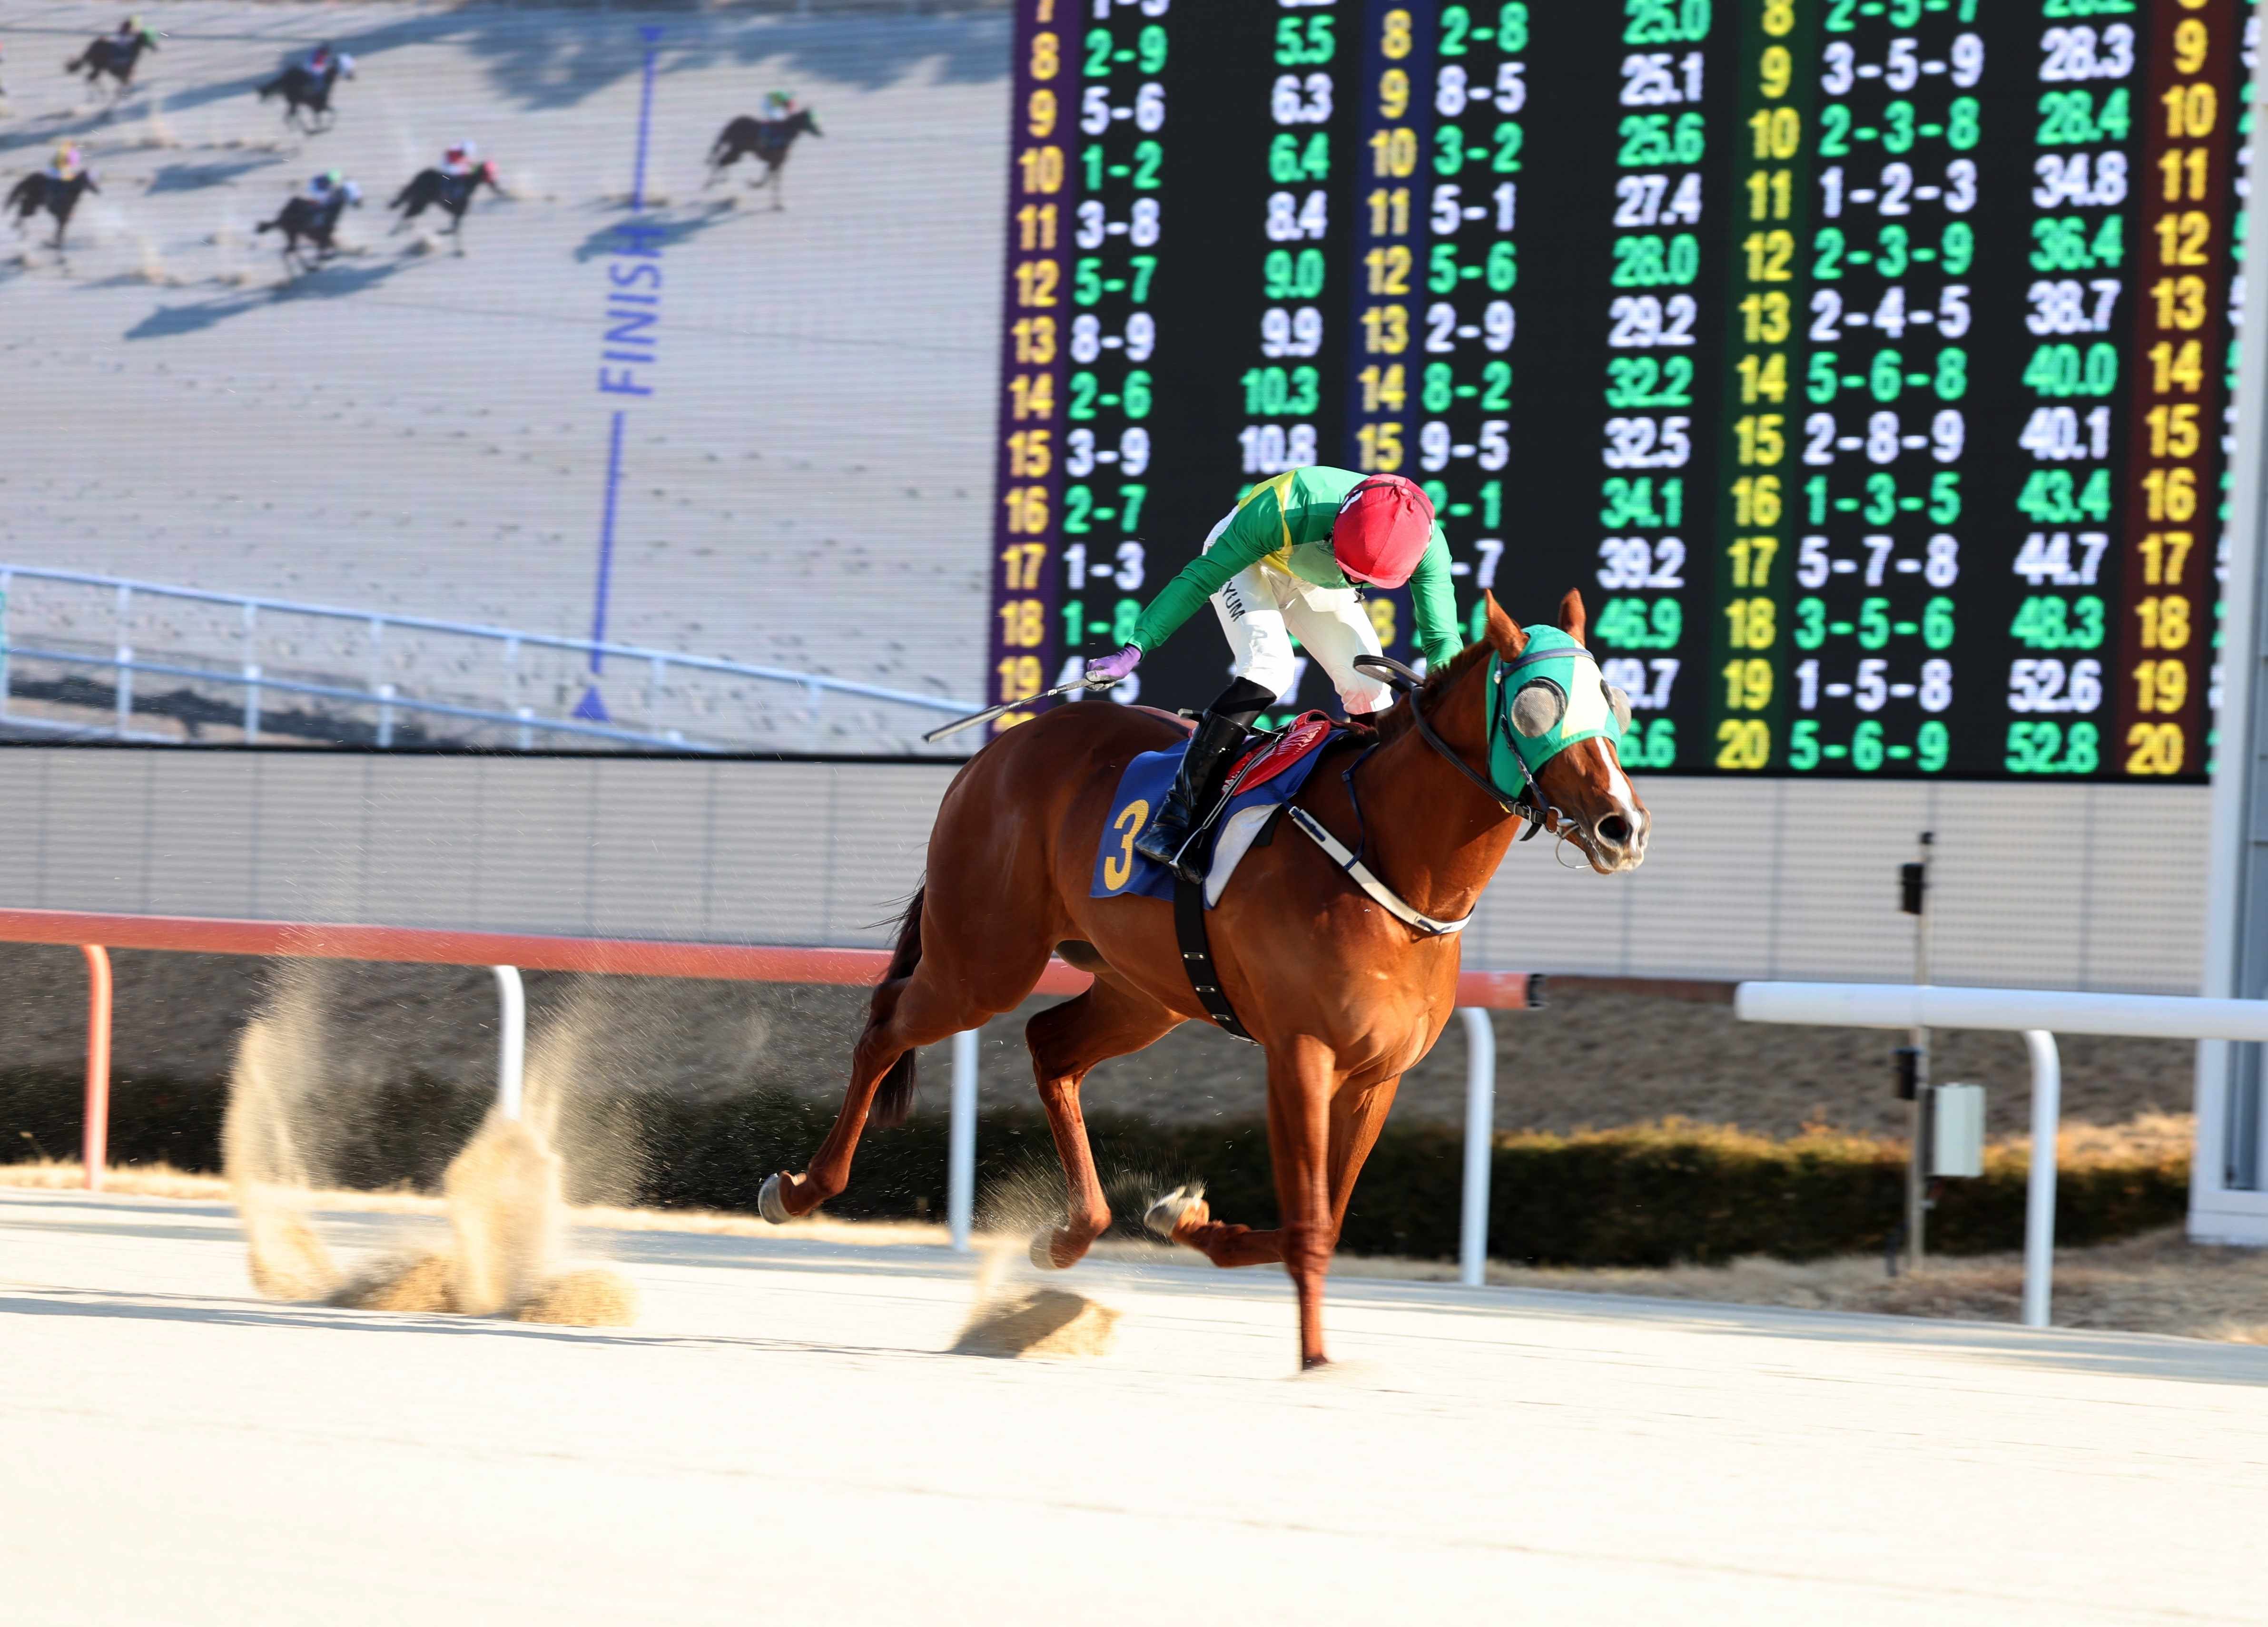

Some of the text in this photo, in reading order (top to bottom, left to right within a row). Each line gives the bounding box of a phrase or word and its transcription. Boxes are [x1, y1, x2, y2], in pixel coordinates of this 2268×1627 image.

[1382, 0, 1711, 59] 8 2-8 25.0
[1763, 0, 1794, 36] 8
[1030, 15, 1335, 80] 8 2-9 5.5
[1760, 24, 2135, 98] 9 3-5-9 28.3
[2174, 19, 2208, 74] 9
[1028, 73, 1333, 138] 9 5-6 6.3
[1380, 52, 1704, 118] 9 8-5 25.1
[2161, 82, 2217, 137] 10
[1370, 112, 1705, 177] 10 3-2 25.6
[1748, 88, 2130, 159] 10 2-3-8 28.4
[1018, 133, 1330, 194] 10 1-2 6.4
[1746, 151, 2128, 220] 11 1-2-3 34.8
[2158, 147, 2208, 202] 11
[1016, 190, 1328, 250] 11 3-8 8.4
[1368, 173, 1702, 235] 11 5-1 27.4
[1365, 234, 1699, 294] 12 5-6 28.0
[1743, 215, 2123, 281] 12 2-3-9 36.4
[2154, 211, 2210, 266] 12
[1015, 249, 1324, 307] 12 5-7 9.0
[2150, 275, 2207, 330] 13
[598, 225, 667, 397] FINISH
[1011, 306, 1322, 364] 13 8-9 9.9
[1361, 294, 1697, 354] 13 2-9 29.2
[1739, 279, 2121, 343] 13 2-4-5 38.7
[1009, 366, 1319, 420] 14 2-6 10.3
[1359, 356, 1693, 412] 14 8-2 32.2
[1736, 343, 2118, 403] 14 5-6-8 40.0
[2148, 340, 2203, 393] 14
[1007, 424, 1318, 478] 15 3-9 10.8
[1357, 416, 1691, 472] 15 9-5 32.5
[1734, 406, 2110, 466] 15 2-8-9 40.1
[2145, 403, 2200, 458] 15
[1004, 484, 1146, 534] 16 2-7
[1601, 478, 1682, 528] 34.1
[1731, 469, 2110, 527] 16 1-3-5 43.4
[2141, 467, 2196, 522] 16
[1001, 541, 1145, 590] 17 1-3
[1597, 537, 1686, 589] 39.2
[1728, 532, 2109, 588] 17 5-7-8 44.7
[2138, 531, 2193, 585] 17
[999, 599, 1141, 648] 18 1-8
[1219, 579, 1246, 622] YUM
[1595, 598, 1681, 649] 46.9
[1726, 596, 2104, 649] 18 3-5-6 48.3
[2135, 595, 2190, 650] 18
[997, 655, 1042, 704] 19
[1723, 658, 2102, 713] 19 1-5-8 52.6
[2133, 659, 2188, 714] 19
[1716, 719, 2098, 773] 20 5-6-9 52.8
[2126, 723, 2184, 774] 20
[1104, 799, 1149, 891] 3
